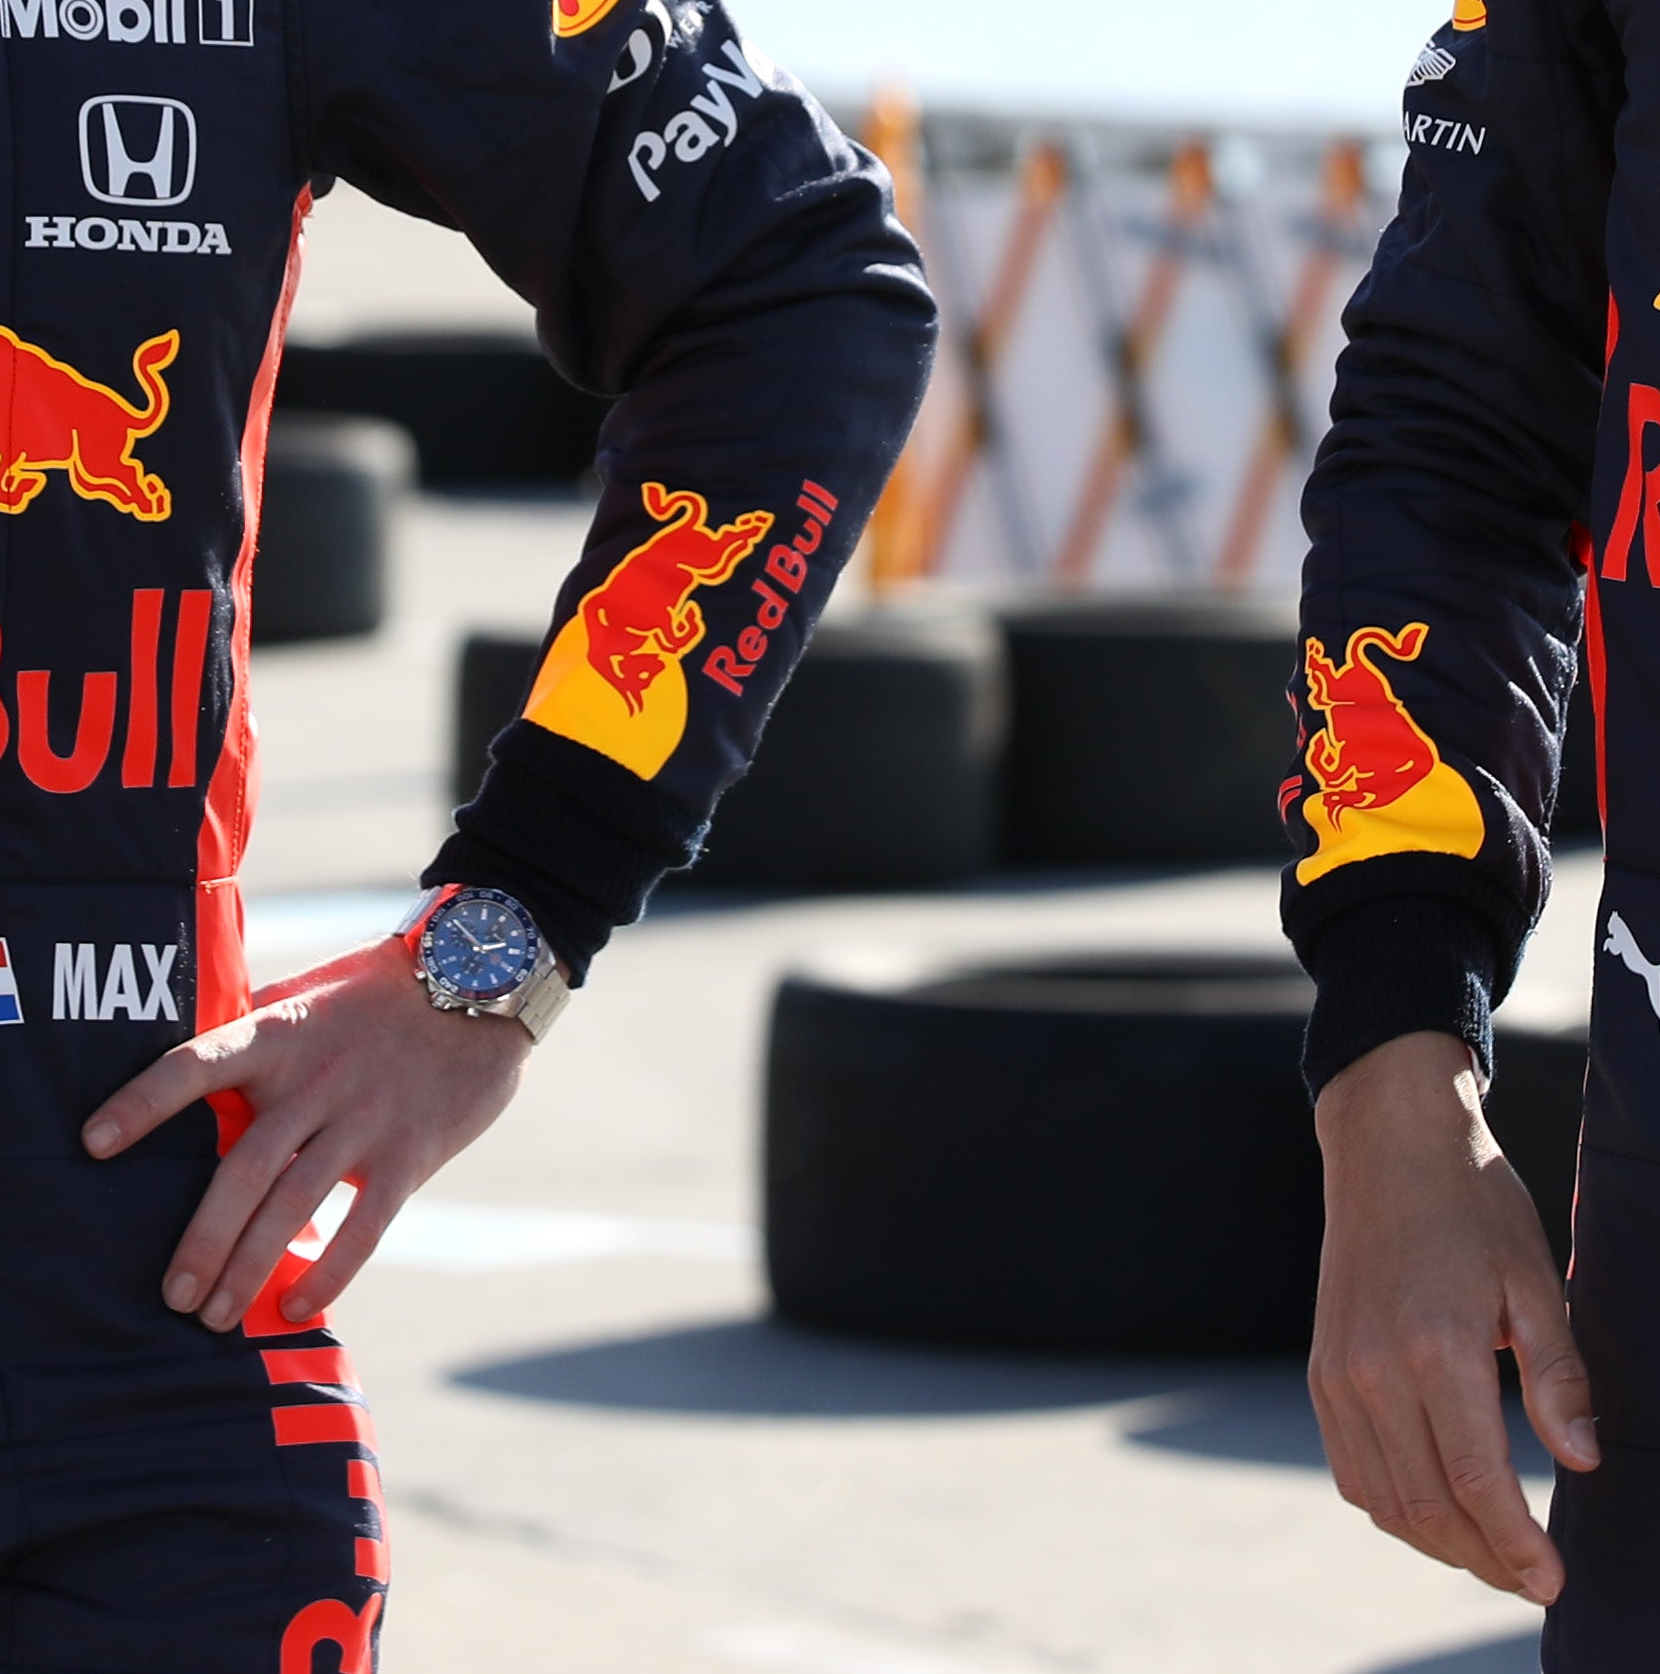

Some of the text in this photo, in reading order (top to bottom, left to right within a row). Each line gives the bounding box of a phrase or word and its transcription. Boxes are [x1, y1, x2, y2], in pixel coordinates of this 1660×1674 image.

[1403, 111, 1487, 156] ARTIN
[24, 215, 232, 255] HONDA
[702, 478, 839, 697] Red Bull
[51, 942, 180, 1022] MAX
